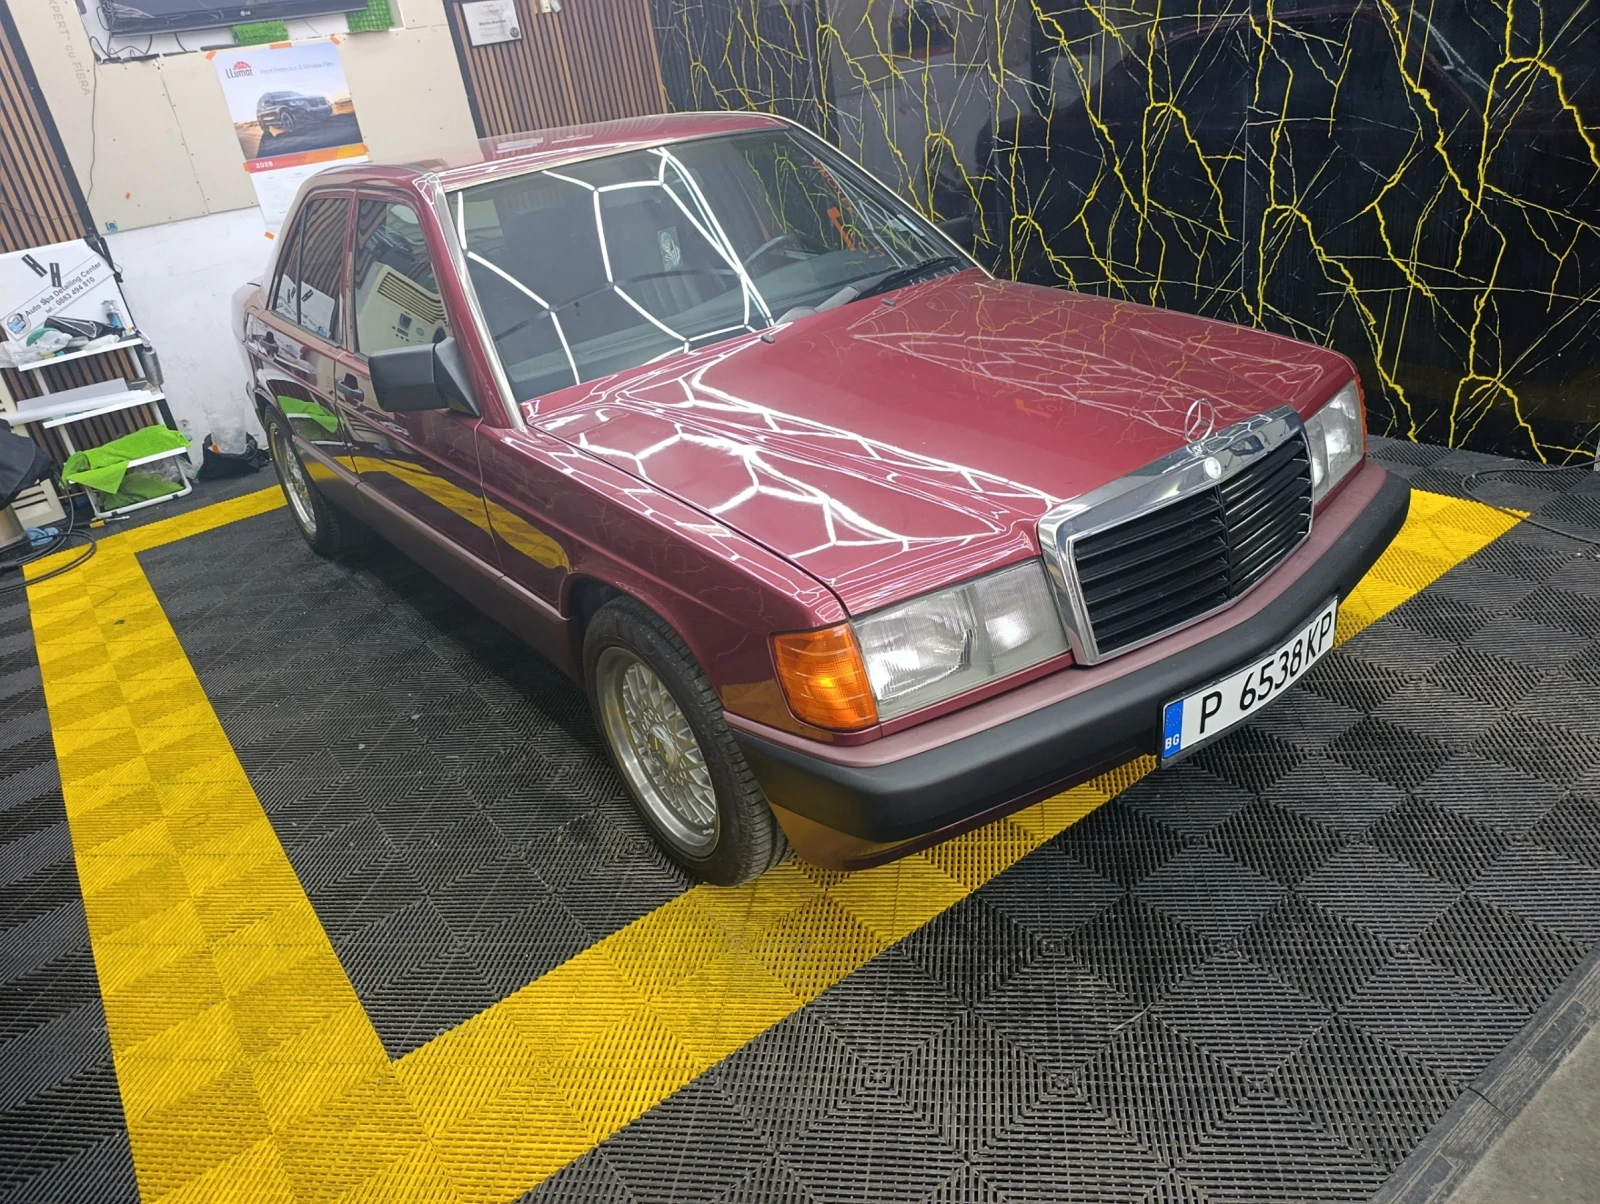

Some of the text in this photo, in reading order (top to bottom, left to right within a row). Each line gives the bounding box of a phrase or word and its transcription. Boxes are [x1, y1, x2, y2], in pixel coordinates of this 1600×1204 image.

[72, 62, 92, 96] FIBRA
[255, 160, 274, 168] 2026
[25, 262, 102, 316] Auto Spa Detailing Center
[56, 292, 72, 306] 0883
[72, 284, 84, 296] 494
[82, 276, 96, 288] 810
[1199, 690, 1222, 734] P
[1165, 733, 1180, 750] BG
